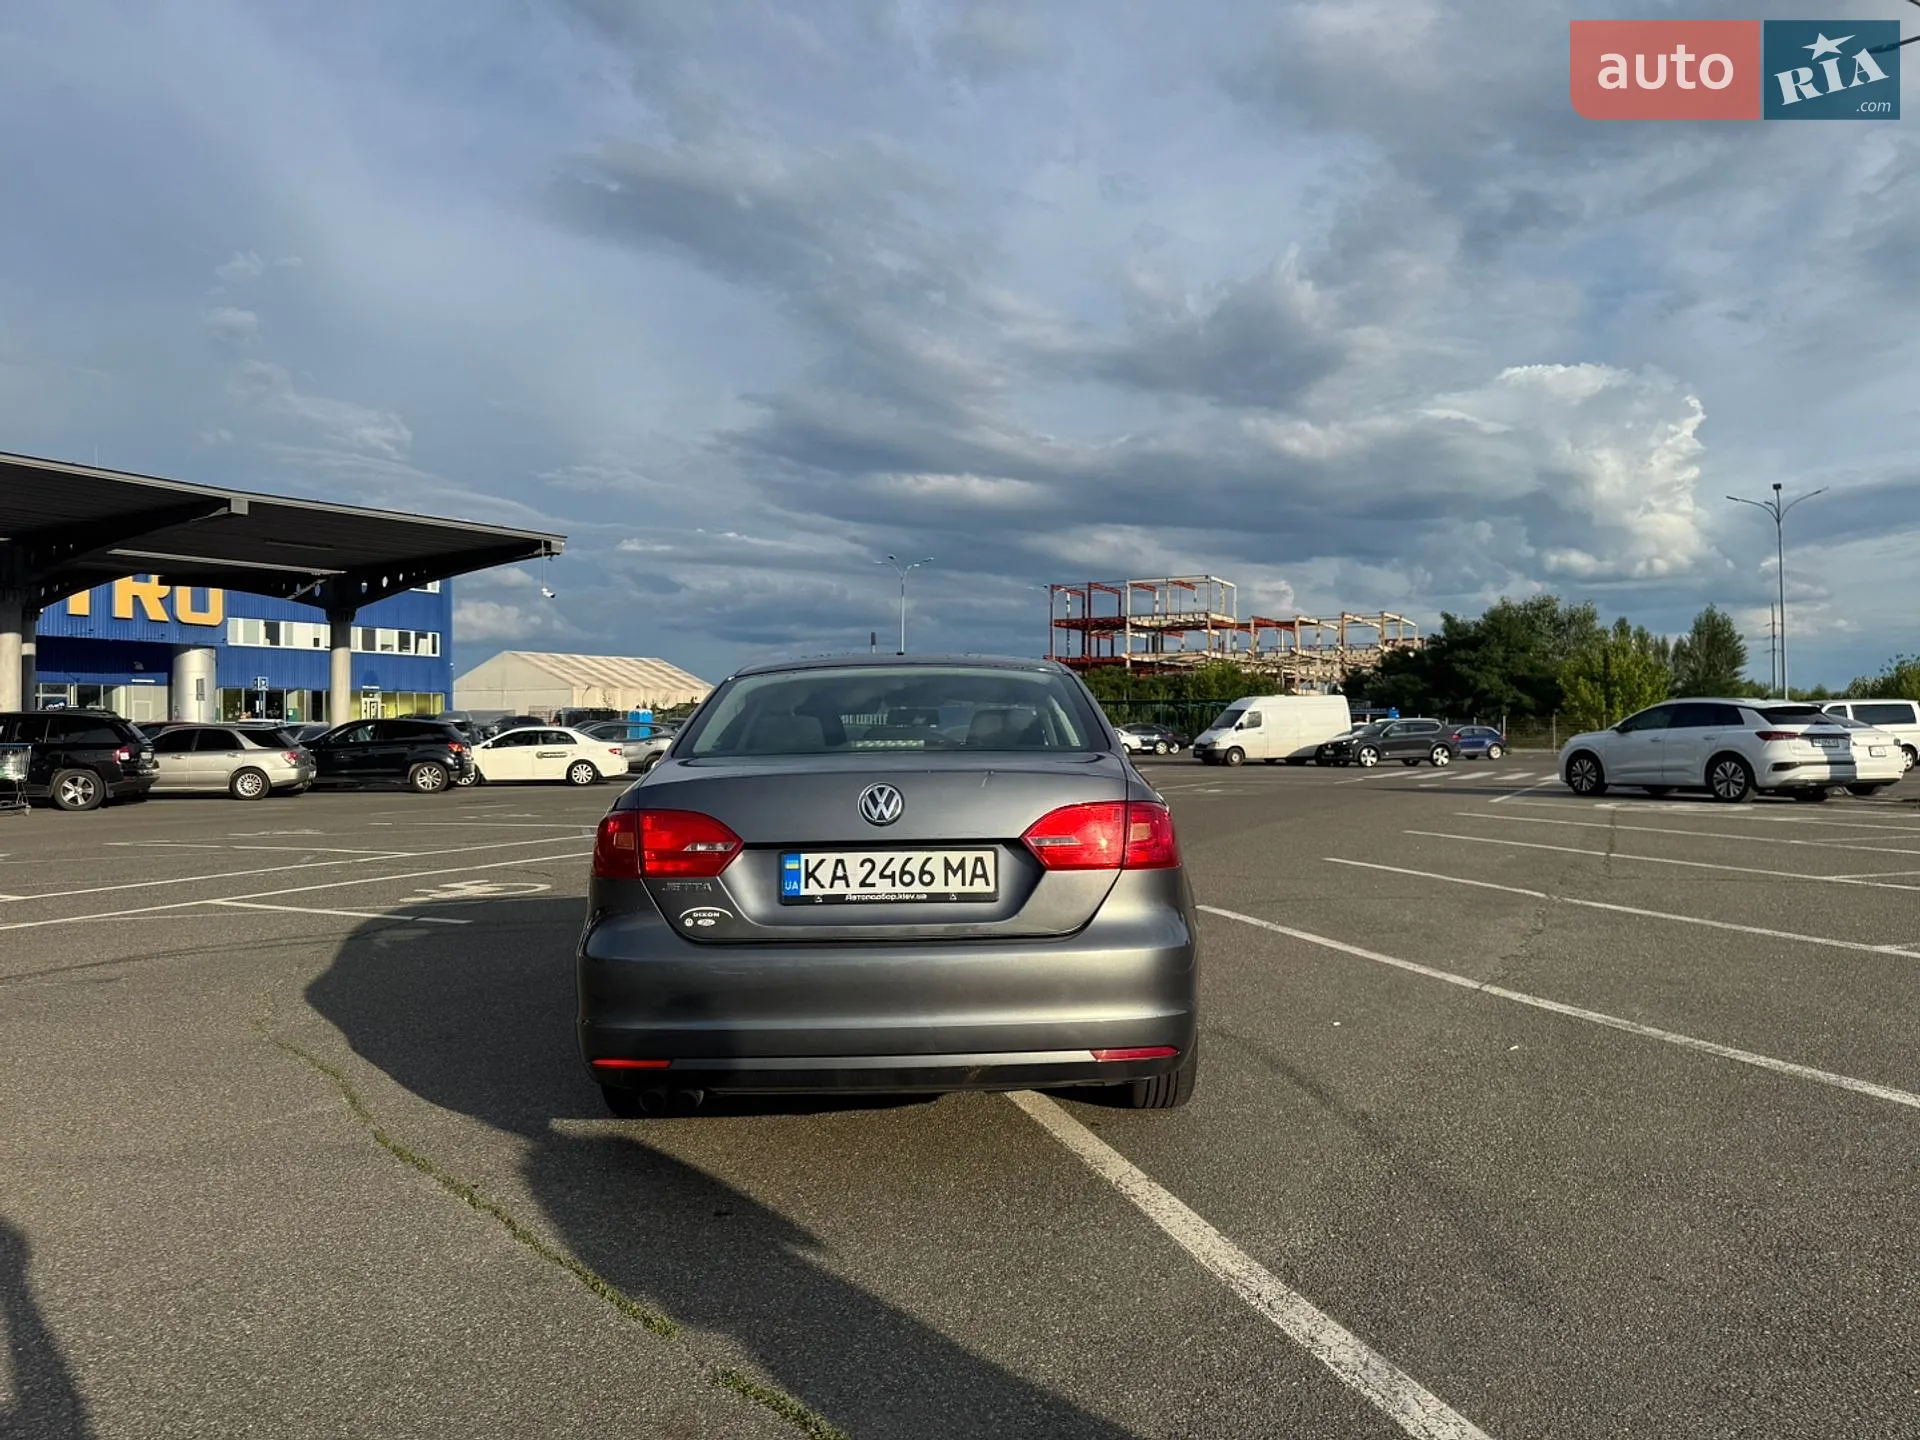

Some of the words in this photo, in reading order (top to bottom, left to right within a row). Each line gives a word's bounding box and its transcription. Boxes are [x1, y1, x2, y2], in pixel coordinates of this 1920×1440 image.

[804, 858, 851, 889] KA
[859, 857, 936, 888] 2466
[943, 856, 990, 887] MA
[784, 881, 799, 891] UA
